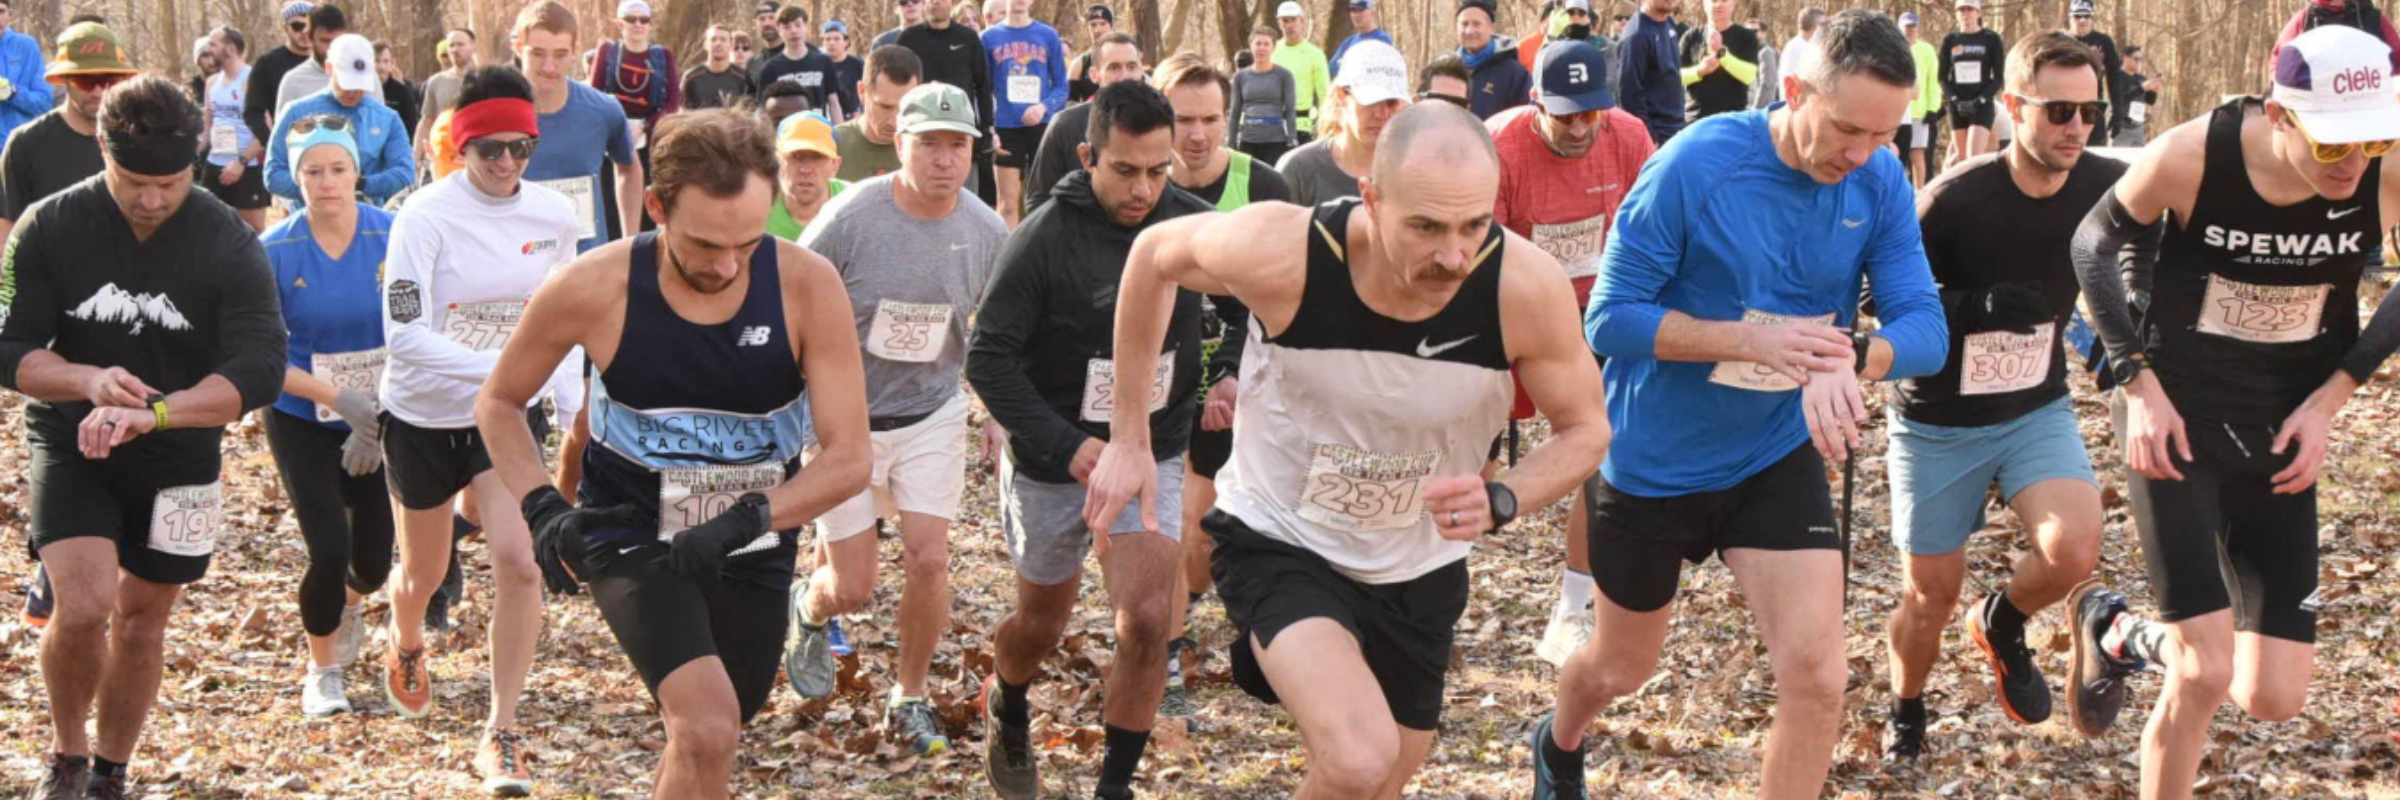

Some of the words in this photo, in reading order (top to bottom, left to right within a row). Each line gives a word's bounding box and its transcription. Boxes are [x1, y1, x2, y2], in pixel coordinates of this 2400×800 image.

[2333, 65, 2382, 95] ciele
[2203, 224, 2363, 257] SPEWAK
[2254, 256, 2305, 267] RACING
[2216, 297, 2310, 332] 123
[884, 323, 930, 351] 25
[1970, 348, 2046, 383] 307
[636, 416, 684, 434] BIG
[693, 415, 777, 438] RIVER
[638, 436, 745, 453] RACING
[1310, 472, 1420, 519] 231
